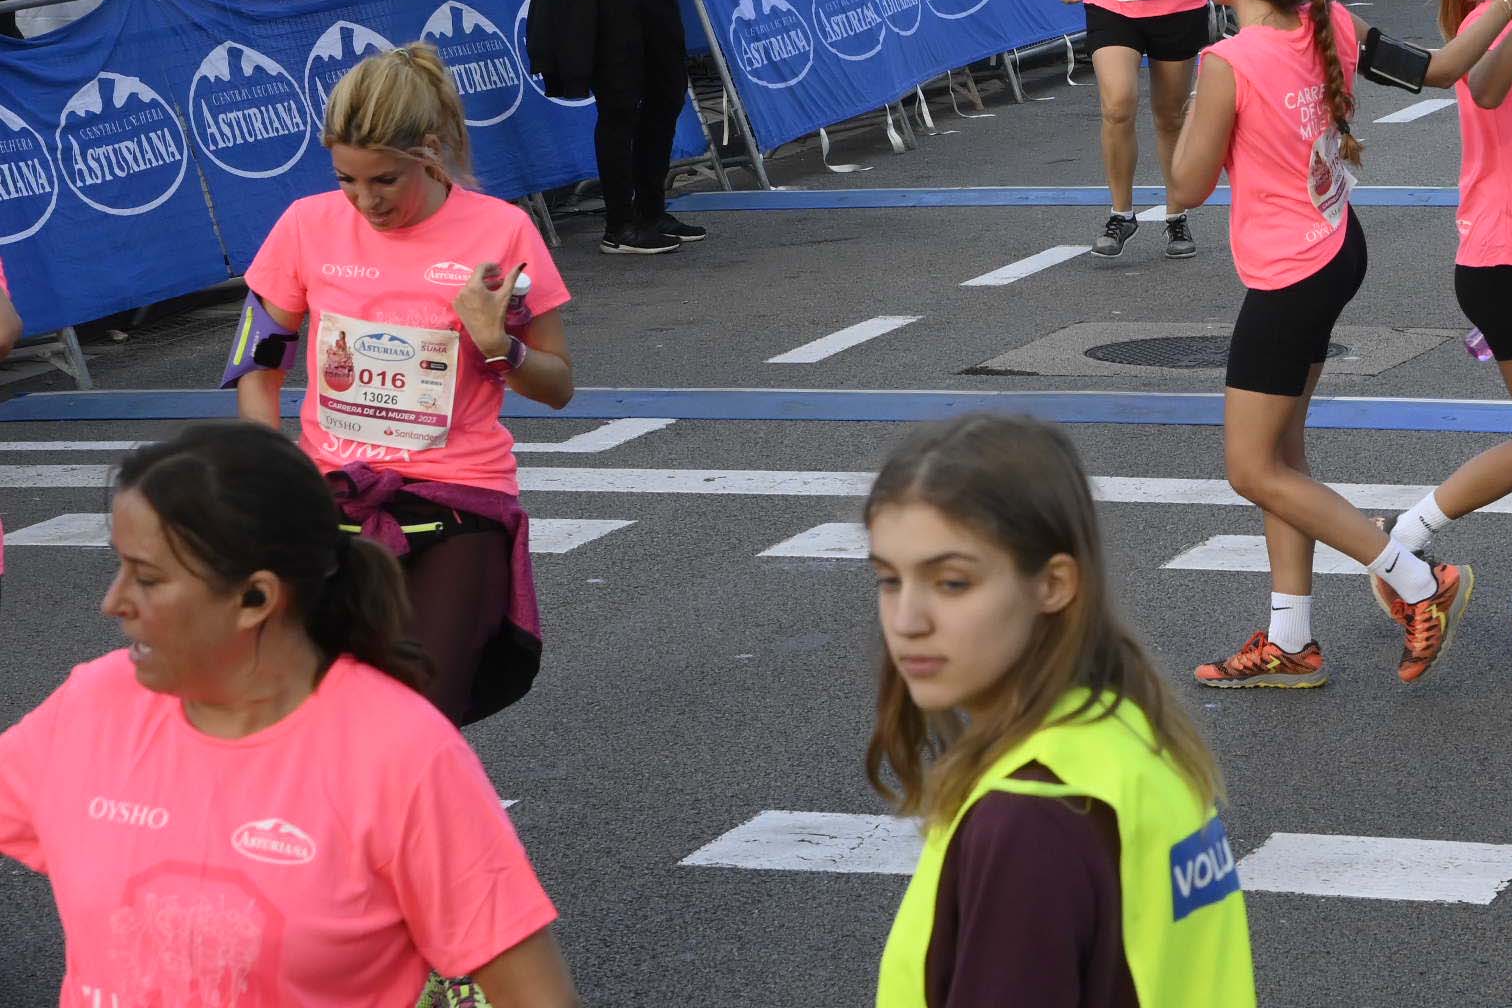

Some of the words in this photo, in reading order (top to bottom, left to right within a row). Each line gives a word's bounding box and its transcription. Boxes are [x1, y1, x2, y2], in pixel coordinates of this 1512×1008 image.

[451, 57, 519, 96] TURIANA
[1284, 82, 1328, 110] CARRE
[201, 96, 305, 152] ASTURIANA
[68, 127, 182, 188] ASTURIANA
[321, 263, 380, 280] OYSHO
[359, 339, 411, 358] ASTURIANA
[358, 368, 407, 389] 016
[362, 391, 399, 406] 13026
[327, 400, 363, 416] CARRERA
[363, 407, 375, 417] DE
[376, 408, 387, 418] LA
[388, 409, 416, 422] MUJER
[325, 414, 362, 434] OYSHO
[88, 795, 169, 830] OYSHO
